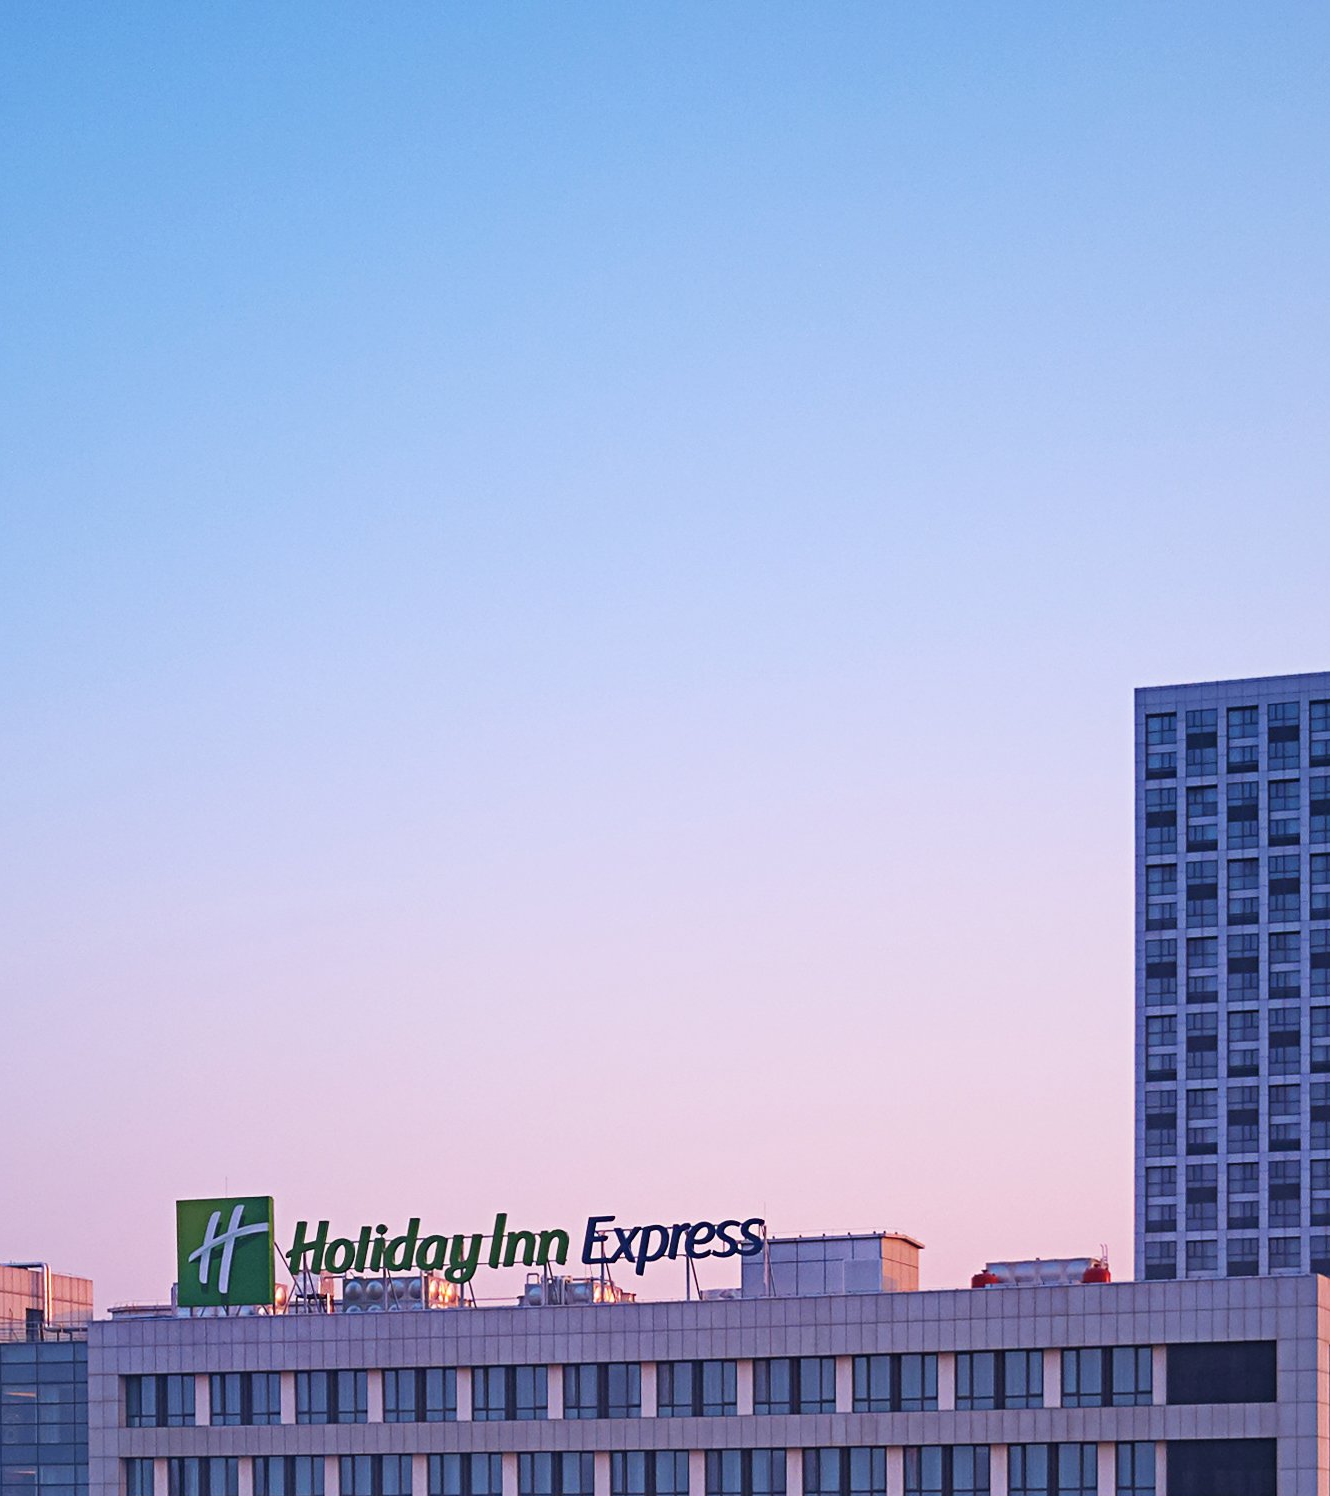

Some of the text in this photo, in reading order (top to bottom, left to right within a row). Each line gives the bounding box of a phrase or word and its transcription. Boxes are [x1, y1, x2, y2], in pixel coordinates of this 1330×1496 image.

[286, 1212, 766, 1284] Holiday Inn Express
